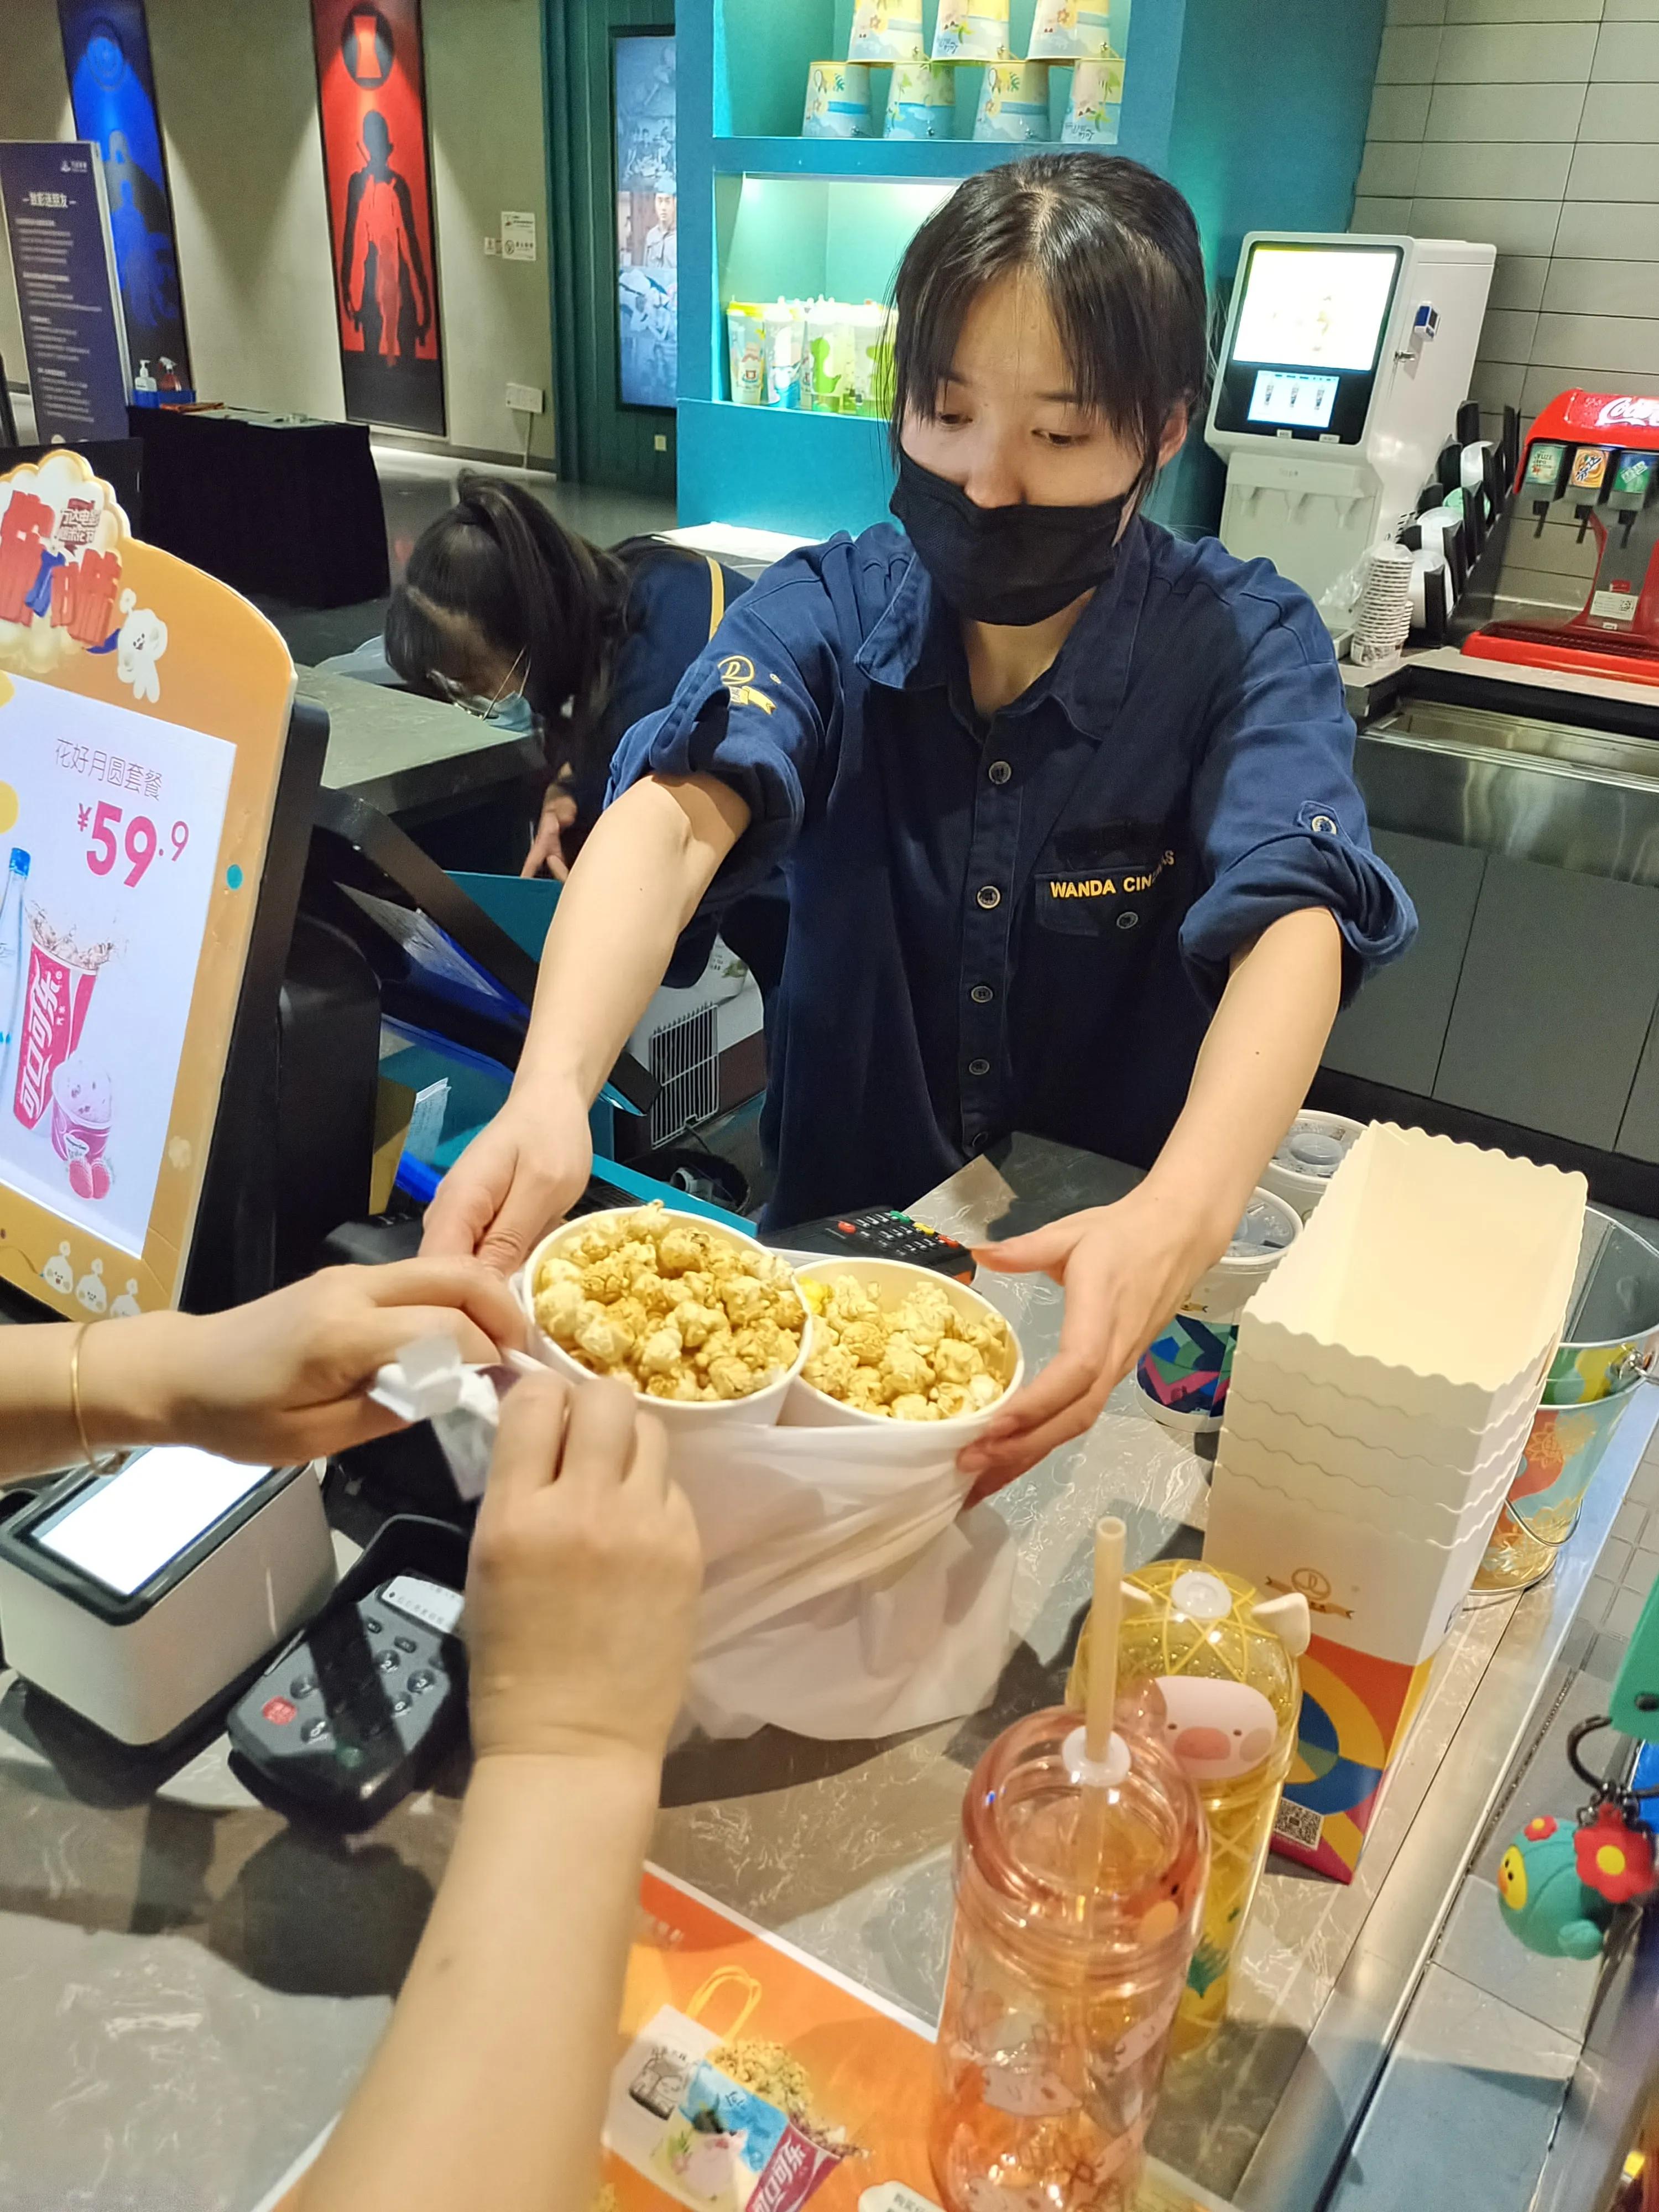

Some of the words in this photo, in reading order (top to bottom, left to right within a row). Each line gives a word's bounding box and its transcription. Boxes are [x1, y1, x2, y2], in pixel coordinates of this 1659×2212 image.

[55, 738, 163, 801] 花好月圆套餐
[1050, 879, 1116, 898] WANDA
